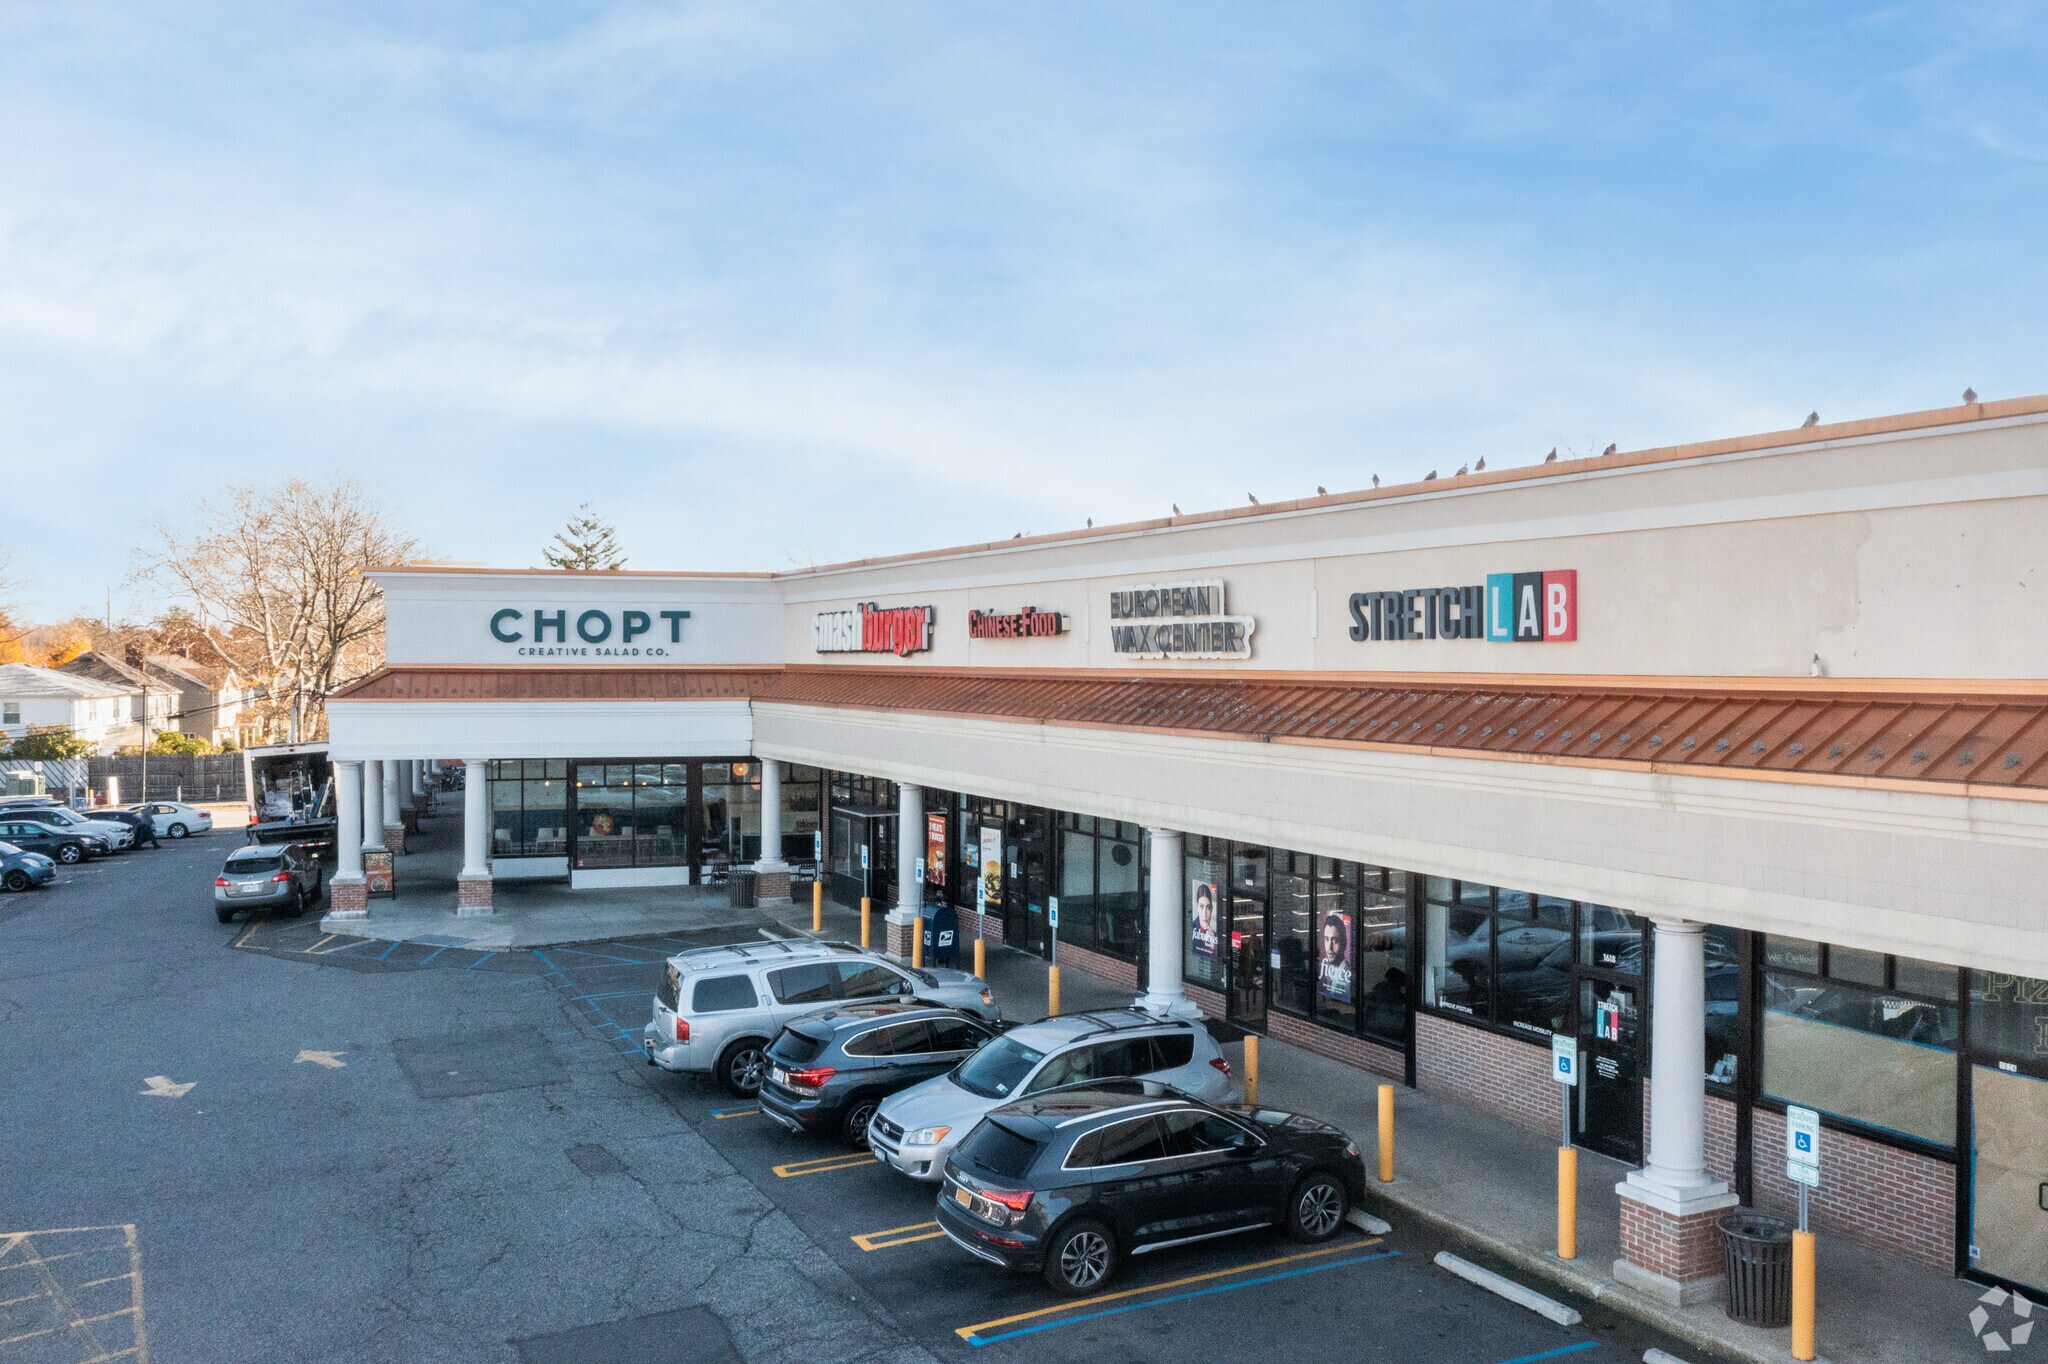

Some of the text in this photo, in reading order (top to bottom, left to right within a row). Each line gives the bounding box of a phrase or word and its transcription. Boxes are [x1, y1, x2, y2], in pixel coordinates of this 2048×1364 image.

[1110, 585, 1219, 619] EUROPEAN
[490, 608, 691, 644] CHOPT
[1110, 621, 1246, 653] WAX CENTER
[518, 647, 670, 657] CREATIVE SALAD CO.
[1319, 957, 1352, 983] fierce
[1602, 953, 1617, 964] 1618
